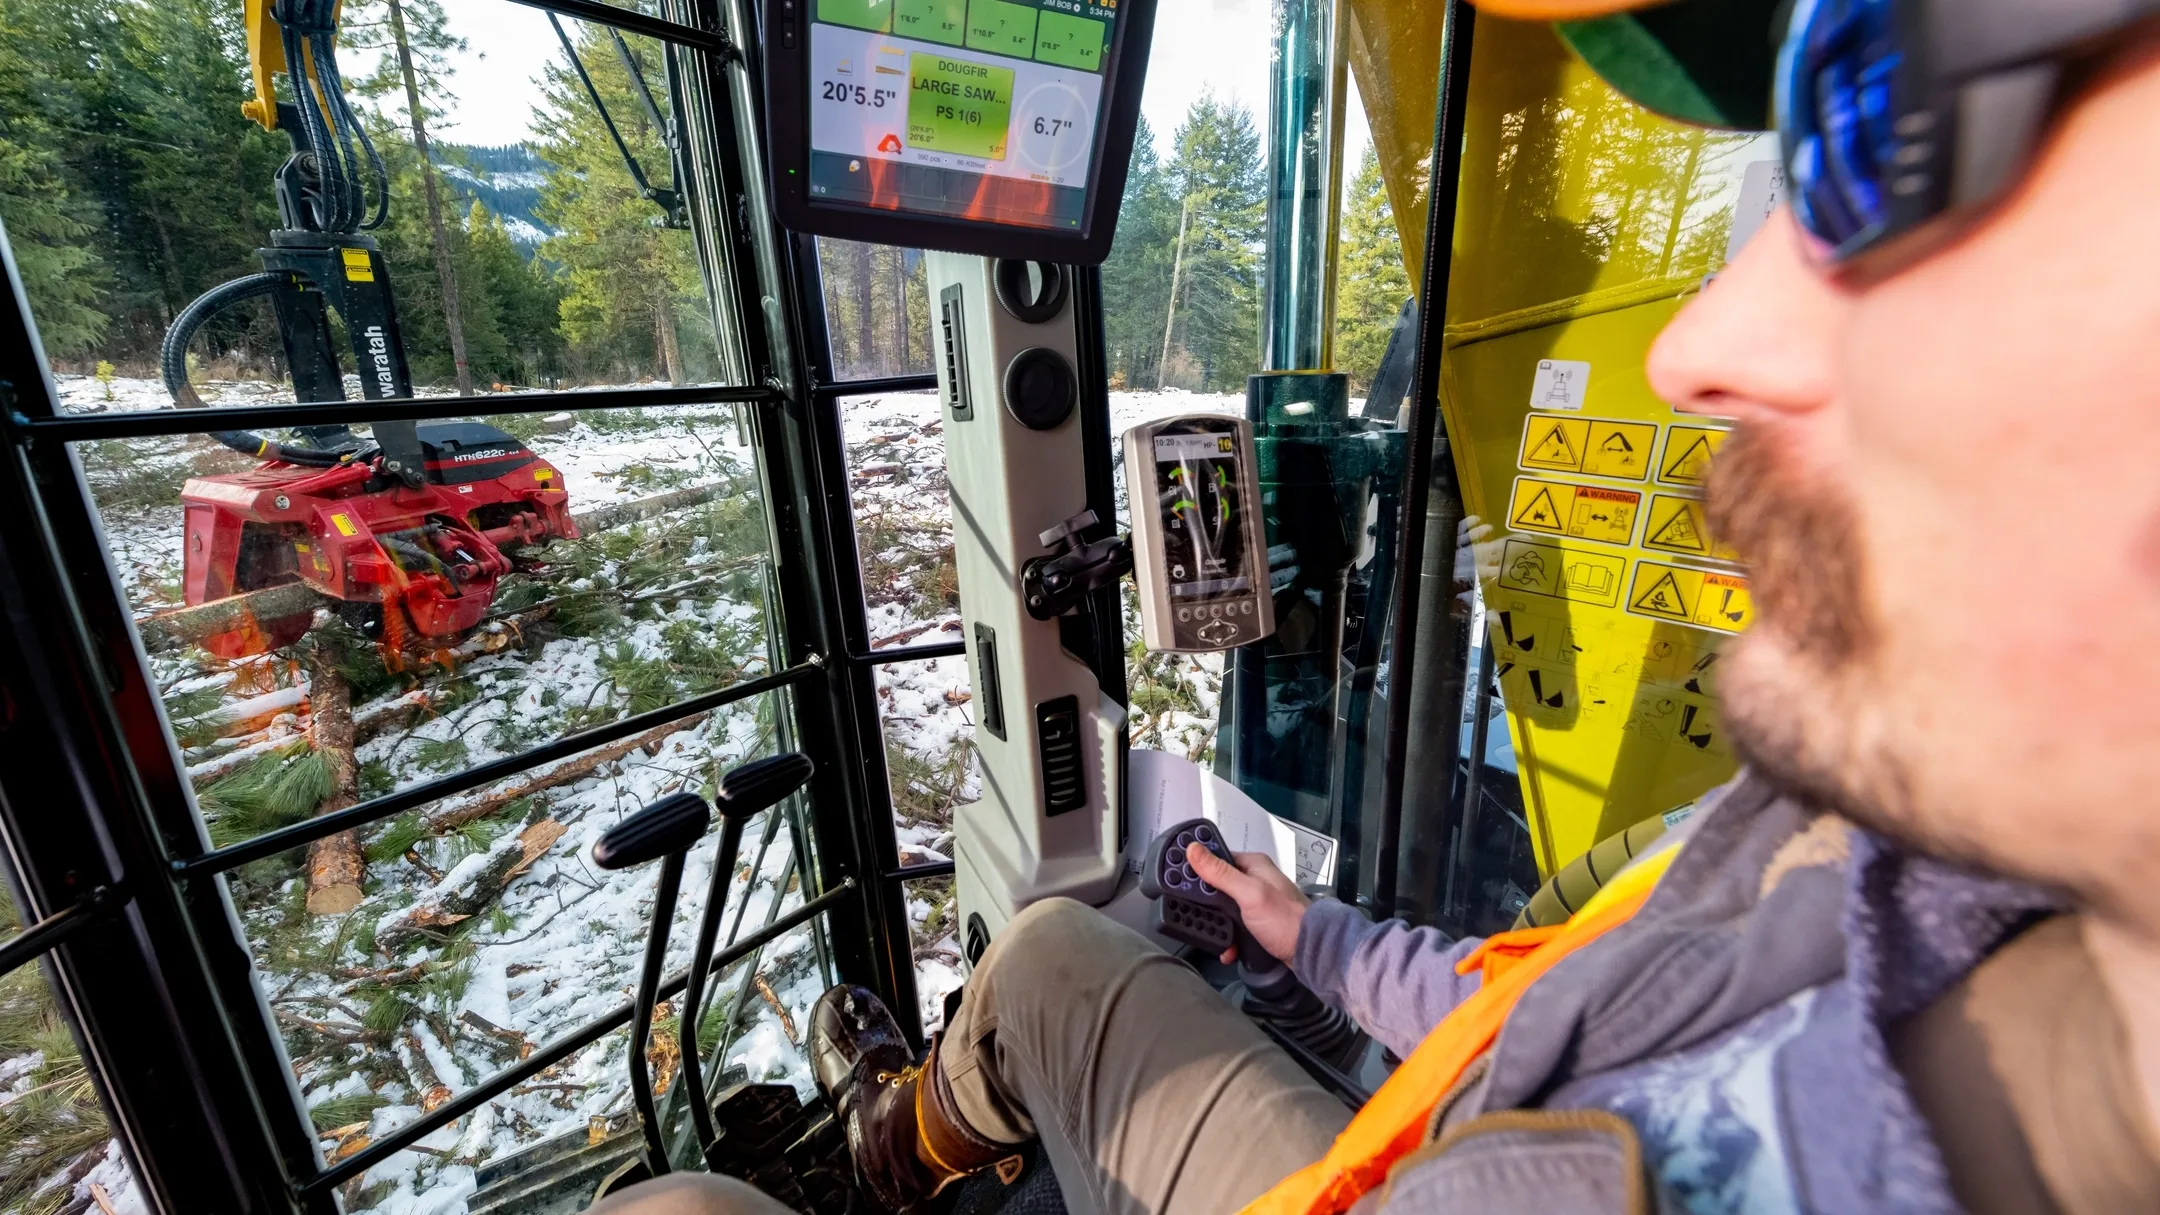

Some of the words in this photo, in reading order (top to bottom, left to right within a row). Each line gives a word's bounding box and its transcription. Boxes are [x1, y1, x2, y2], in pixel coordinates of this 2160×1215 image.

[1056, 0, 1072, 10] BOB
[1089, 7, 1103, 16] 5:34
[1104, 10, 1115, 19] PM
[938, 60, 988, 79] DOUGFIR
[822, 80, 896, 108] 20'5.5"
[912, 76, 960, 97] LARGE
[963, 85, 1006, 105] SAW...
[936, 105, 954, 120] PS
[958, 109, 982, 127] 1(6)
[1034, 116, 1072, 136] 6.7"
[364, 325, 396, 398] waratah
[1155, 438, 1175, 447] 10:20
[1218, 438, 1231, 451] 10
[454, 449, 505, 463] HTH622C
[1590, 489, 1636, 504] WARNING
